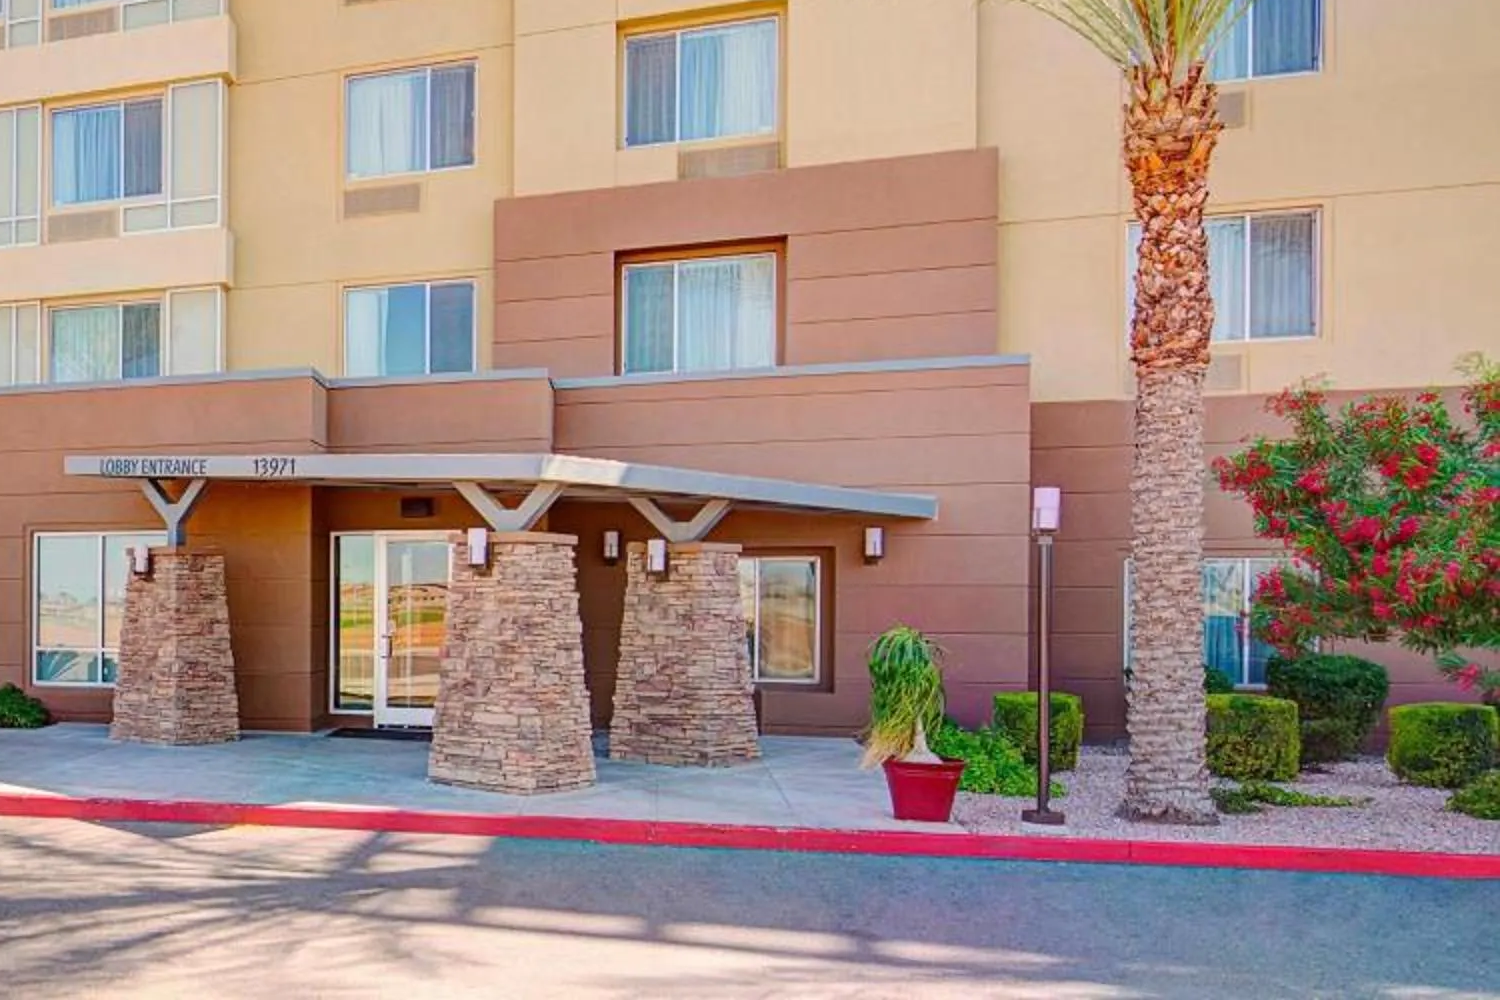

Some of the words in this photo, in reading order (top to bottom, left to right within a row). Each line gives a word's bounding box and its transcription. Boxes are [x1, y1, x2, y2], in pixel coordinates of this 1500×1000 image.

[100, 458, 139, 476] LOBBY
[141, 458, 207, 475] ENTRANCE
[253, 457, 296, 475] 13971
